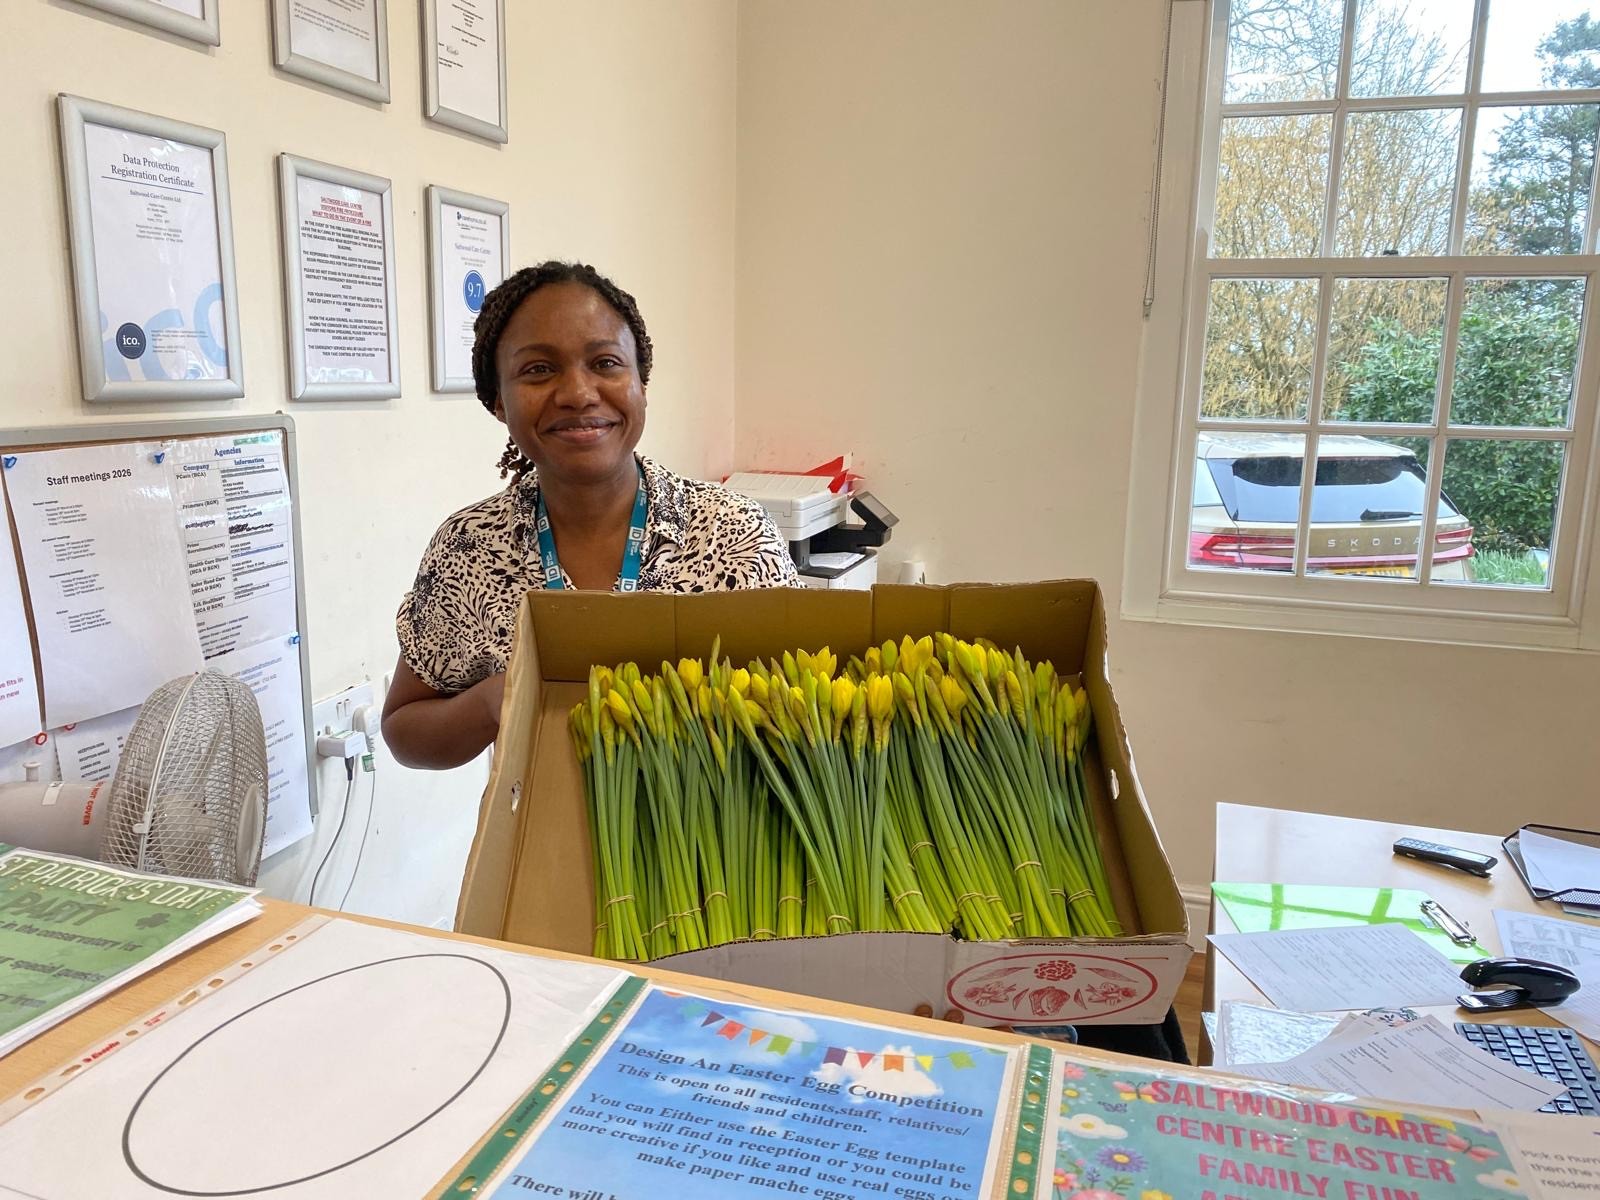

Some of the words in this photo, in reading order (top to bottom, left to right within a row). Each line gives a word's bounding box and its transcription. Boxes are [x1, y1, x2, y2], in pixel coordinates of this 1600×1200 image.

[123, 153, 142, 166] Data
[143, 158, 180, 173] Protection
[111, 164, 158, 182] Registration
[159, 174, 195, 188] Certificate
[467, 282, 482, 298] 9.7
[122, 334, 140, 346] ico.
[214, 447, 242, 457] Agencies
[183, 464, 210, 472] Company
[234, 458, 264, 466] Information
[46, 475, 69, 486] Staff
[70, 471, 111, 484] meetings
[112, 468, 132, 479] 2026
[540, 519, 549, 530] ID
[631, 528, 642, 539] ID
[1328, 536, 1423, 548] SKODA
[548, 568, 558, 580] ID
[623, 580, 634, 591] ID
[6, 690, 20, 699] new
[83, 800, 94, 825] COVER
[31, 863, 163, 901] PATRICK'S
[151, 885, 221, 910] DAY
[619, 1042, 686, 1066] Design
[690, 1057, 721, 1072] An
[727, 1063, 795, 1084] Easter
[800, 1076, 842, 1096] Egg
[848, 1084, 985, 1119] Competition
[618, 1063, 650, 1079] This
[653, 1070, 667, 1082] is
[671, 1076, 709, 1093] open
[714, 1083, 730, 1093] to
[734, 1087, 756, 1099] all
[888, 1114, 971, 1137] relatives/
[690, 1092, 751, 1112] friends
[753, 1105, 788, 1118] and
[791, 1112, 867, 1133] children.
[1150, 1080, 1338, 1129] SALTWOOD
[1348, 1110, 1448, 1148] CARE
[590, 1092, 621, 1108] You
[625, 1103, 654, 1115] can
[658, 1107, 714, 1126] Either
[717, 1120, 745, 1132] use
[749, 1125, 777, 1138] the
[781, 1129, 840, 1151] Easter
[844, 1141, 880, 1160] Egg
[885, 1149, 966, 1174] template
[562, 1120, 607, 1134] more
[611, 1129, 679, 1150] creative
[683, 1142, 701, 1154] if
[697, 1149, 732, 1164] you
[738, 1154, 772, 1169] like
[775, 1164, 811, 1177] and
[816, 1172, 847, 1184] use
[851, 1179, 889, 1193] real
[569, 1105, 605, 1119] that
[604, 1112, 637, 1127] you
[642, 1119, 673, 1133] will
[675, 1126, 712, 1141] find
[716, 1134, 733, 1146] in
[738, 1141, 821, 1164] reception
[827, 1157, 848, 1168] or
[851, 1163, 885, 1177] you
[892, 1169, 944, 1186] could
[950, 1178, 972, 1191] be
[1156, 1115, 1298, 1158] CENTRE
[1307, 1138, 1456, 1185] EASTER
[636, 1152, 686, 1170] make
[688, 1164, 744, 1183] paper
[748, 1175, 809, 1194] mache
[1198, 1153, 1329, 1199] FAMILY
[1530, 1163, 1566, 1174] then
[1567, 1168, 1592, 1177] the
[511, 1175, 563, 1196] There
